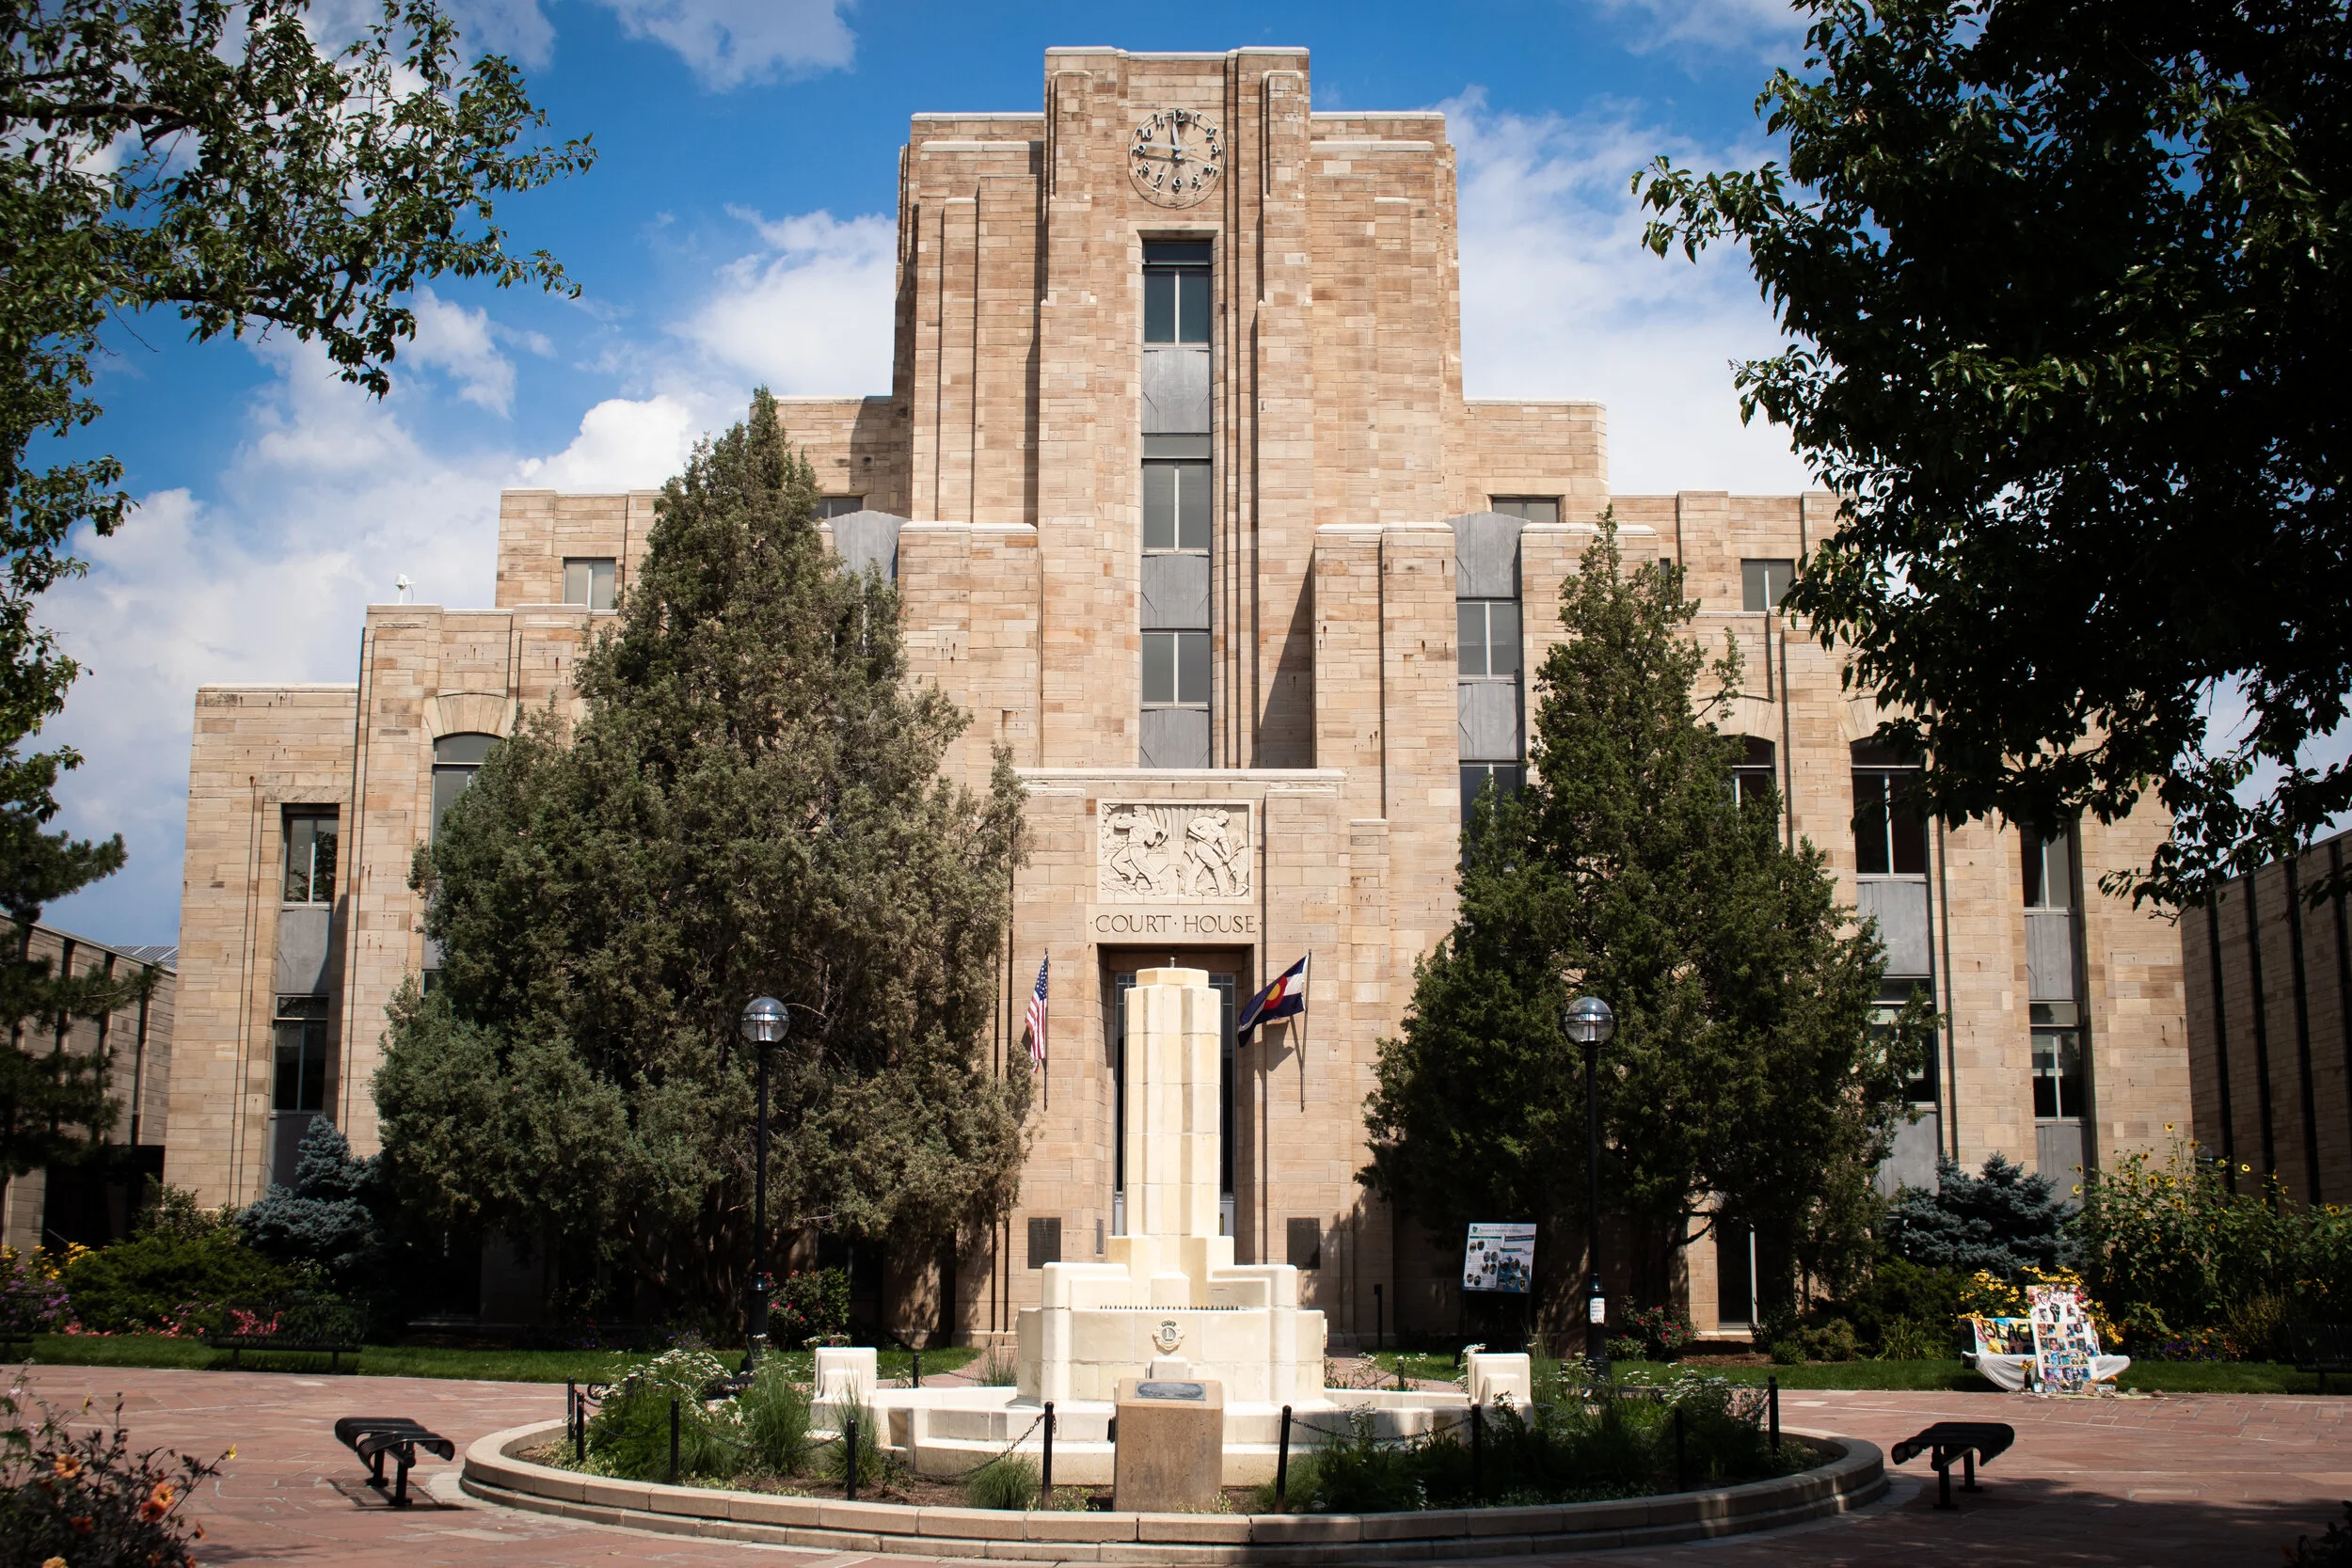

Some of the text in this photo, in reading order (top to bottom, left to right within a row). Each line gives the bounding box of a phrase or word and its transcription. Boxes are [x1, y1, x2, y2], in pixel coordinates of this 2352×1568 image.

[1155, 114, 1165, 126] 11
[1173, 110, 1184, 122] 12
[1140, 128, 1152, 139] 10
[1207, 129, 1215, 138] 2
[1136, 145, 1146, 154] 9
[1211, 144, 1218, 155] 3
[1143, 161, 1151, 172] 8
[1157, 172, 1165, 184] 7
[1173, 176, 1182, 185] 6
[1192, 173, 1199, 183] 5
[1095, 914, 1256, 933] COURT HOUSE
